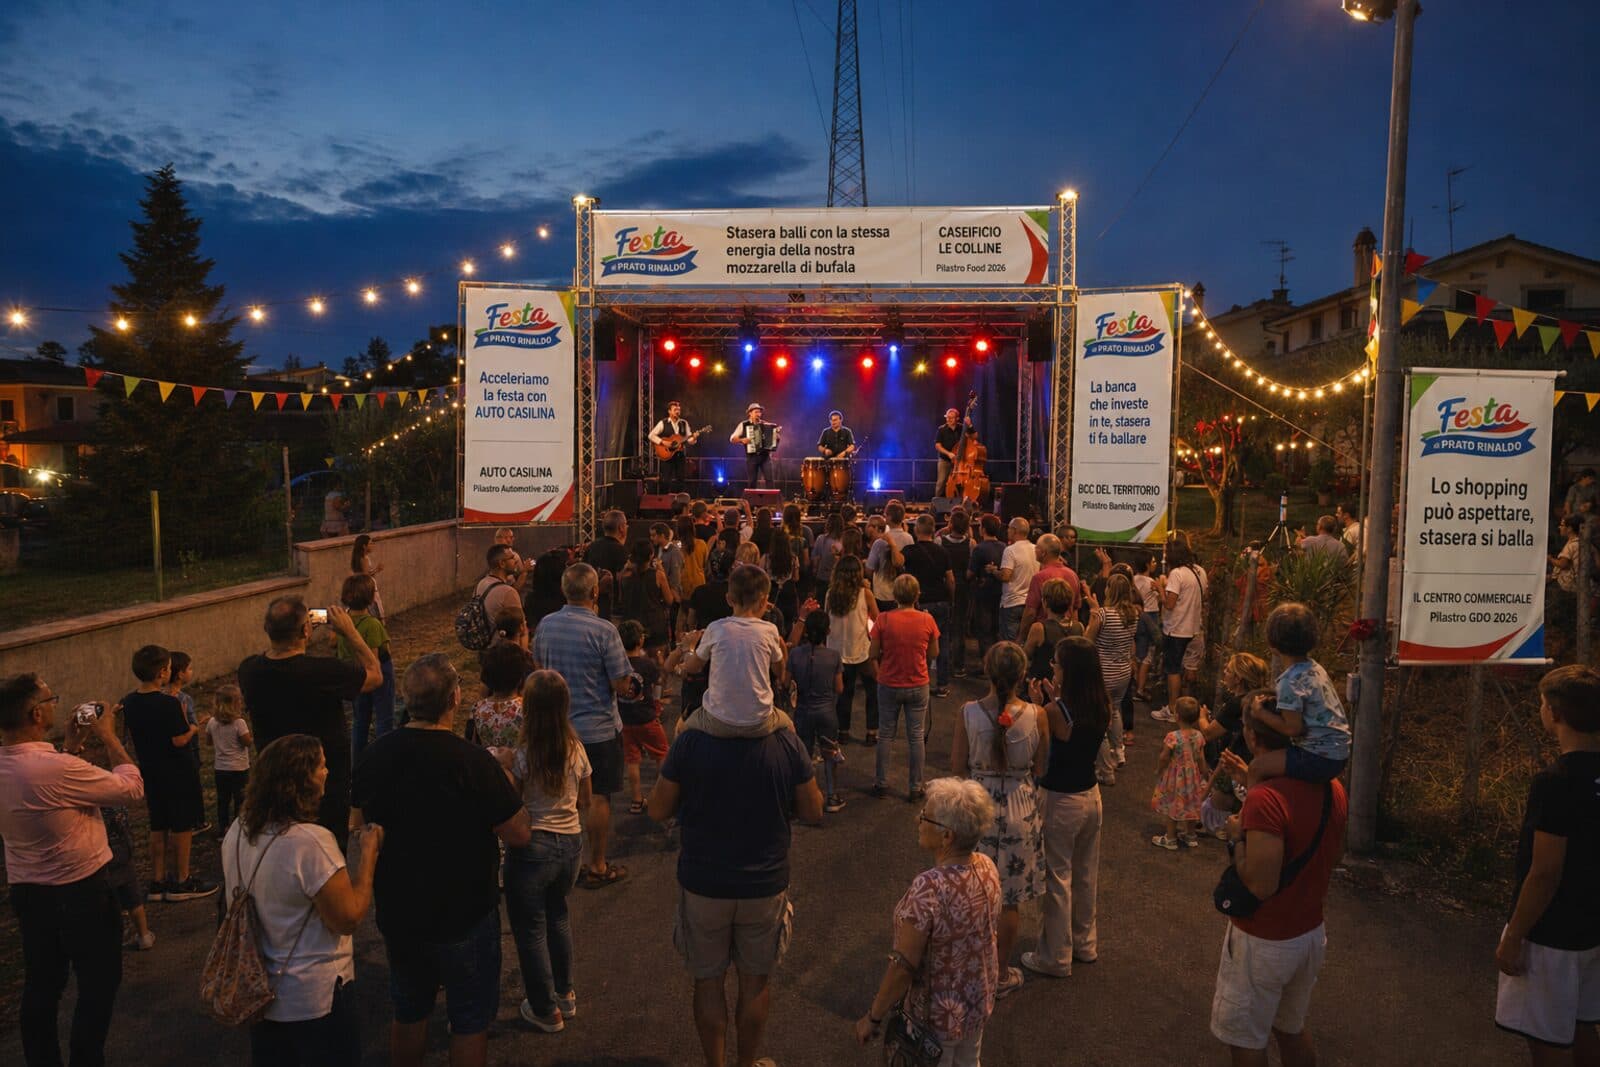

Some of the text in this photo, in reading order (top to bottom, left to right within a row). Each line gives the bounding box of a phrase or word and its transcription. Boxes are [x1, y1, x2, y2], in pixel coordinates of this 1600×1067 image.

[726, 226, 890, 239] Stasera balli con la stessa
[938, 227, 1001, 238] CASEIFICIO
[614, 225, 683, 255] Festa
[726, 242, 855, 258] energia della nostra
[939, 243, 1001, 254] LE COLLINE
[617, 261, 646, 273] PRATO
[647, 262, 686, 273] RINALDO
[726, 260, 856, 274] mozzarella di bufala
[936, 264, 1006, 272] Pilastro Food 2026
[486, 302, 549, 330] Festa
[1096, 310, 1153, 339] Festa
[490, 335, 516, 344] PRATO
[518, 336, 552, 345] RINALDO
[480, 372, 549, 385] Acceleriamo
[1090, 381, 1136, 393] La banca
[484, 389, 547, 401] la festa con
[1090, 398, 1148, 410] che investe
[475, 407, 555, 419] AUTO CASILINA
[1438, 397, 1519, 433] Festa
[1089, 416, 1150, 428] in te, stasera
[1089, 432, 1146, 444] ti fa ballare
[1441, 440, 1475, 450] PRATO
[1477, 442, 1522, 451] RINALDO
[480, 467, 552, 477] AUTO CASILINA
[473, 484, 559, 493] Pilastro Automotive 2026
[1078, 484, 1160, 496] BCC DEL TERRITORIO
[1431, 478, 1527, 500] Lo shopping
[1082, 501, 1154, 512] Pilastro Banking 2026
[1424, 503, 1534, 524] può aspettare,
[1420, 529, 1533, 546] stasera si balla
[1413, 593, 1532, 604] IL CENTRO COMMERCIALE
[1430, 612, 1518, 623] Pilastro GDO 2026
